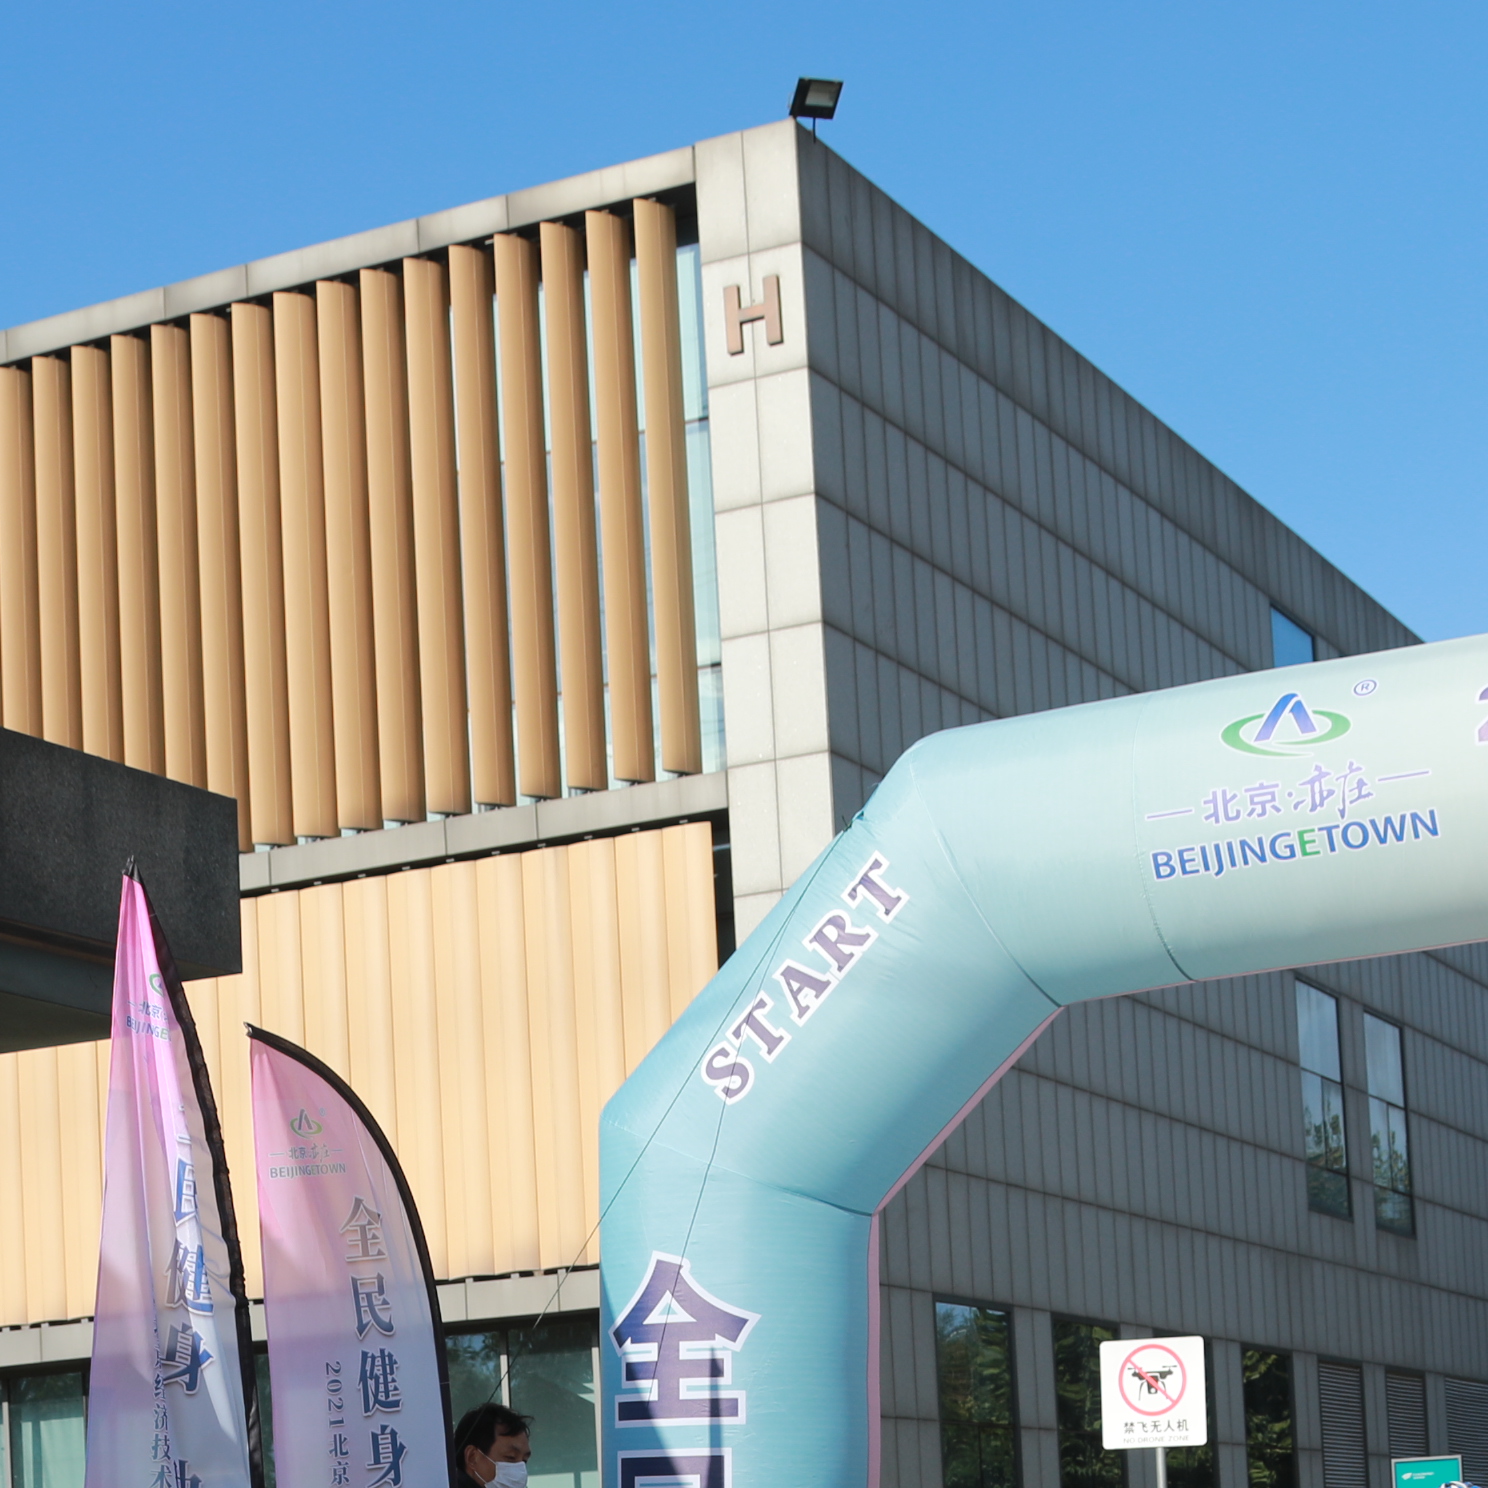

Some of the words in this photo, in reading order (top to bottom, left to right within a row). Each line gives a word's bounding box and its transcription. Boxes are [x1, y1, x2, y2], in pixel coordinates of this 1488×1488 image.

[723, 274, 784, 356] H
[1151, 809, 1441, 881] BEIJINGETOWN
[702, 852, 908, 1104] START
[269, 1161, 347, 1181] BEIJINGETOWN
[1123, 1419, 1189, 1434] 禁飞无人机
